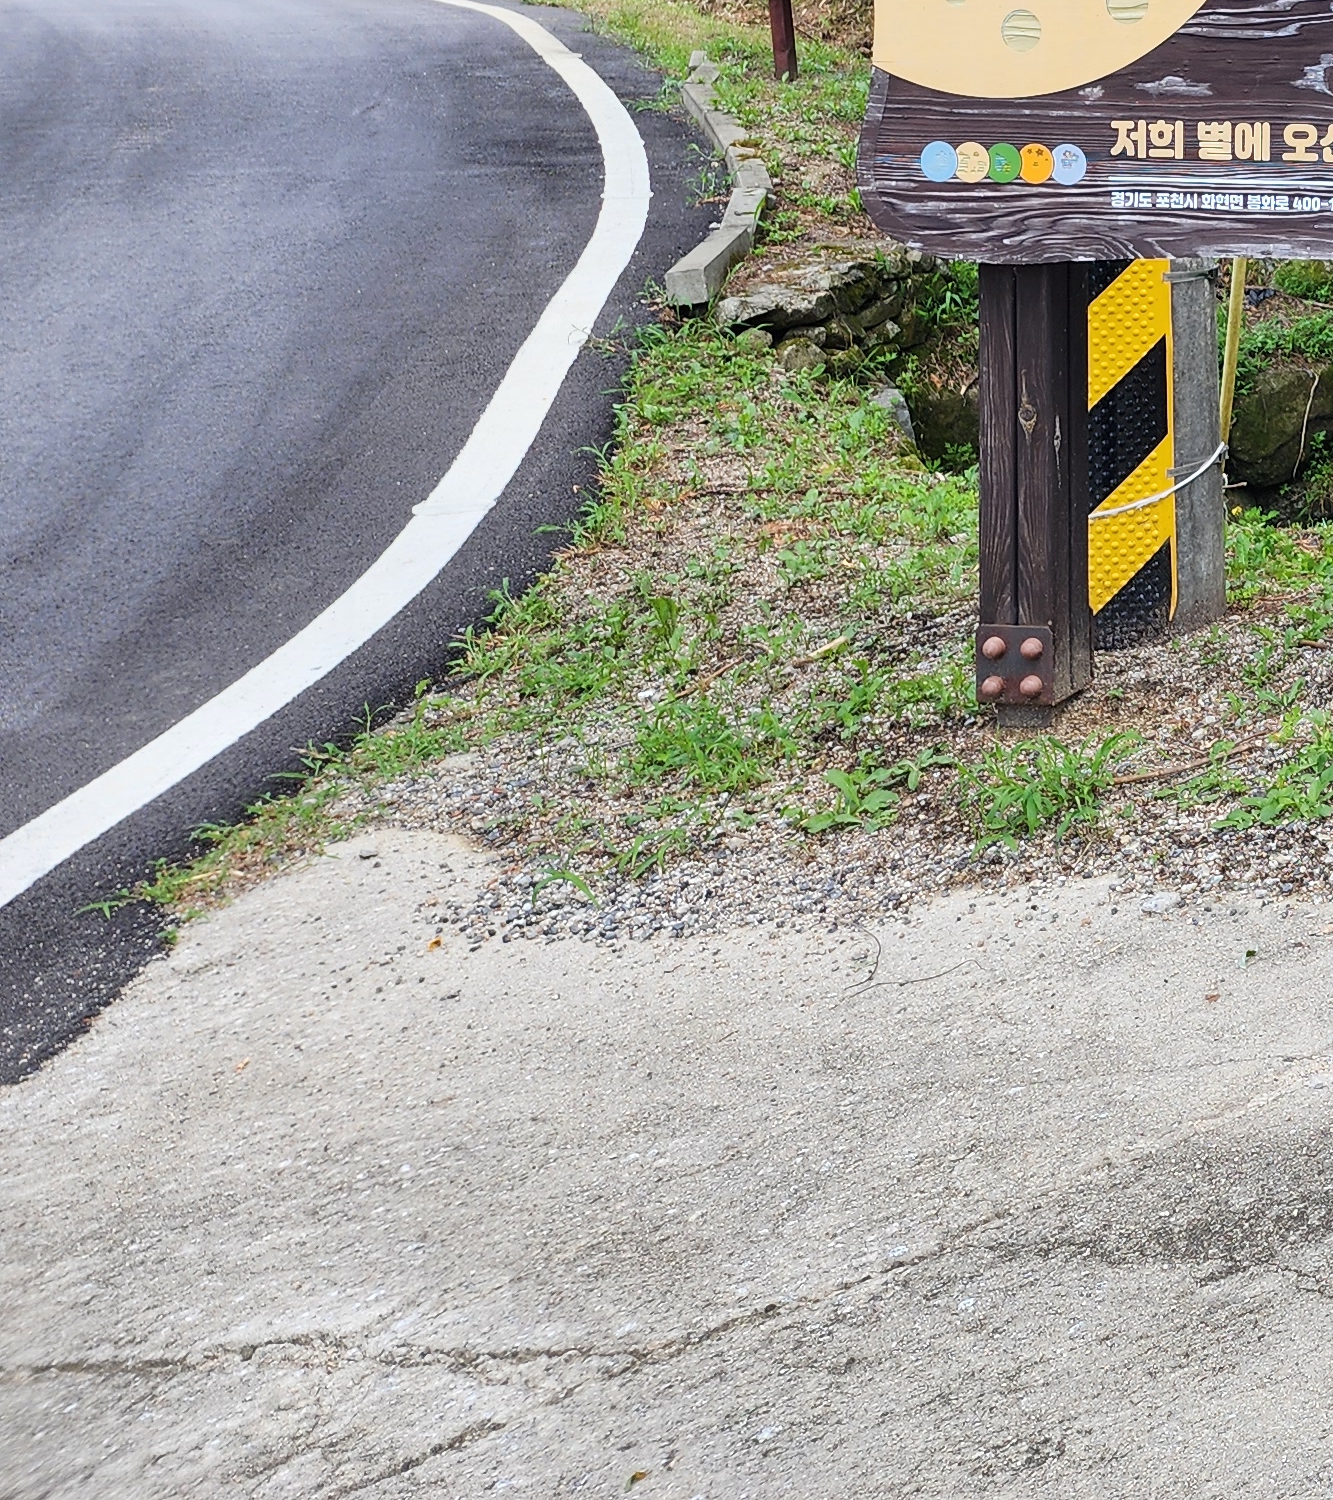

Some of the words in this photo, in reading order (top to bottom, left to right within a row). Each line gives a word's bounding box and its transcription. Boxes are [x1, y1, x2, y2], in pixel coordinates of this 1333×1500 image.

[1110, 119, 1184, 160] 저희
[1197, 120, 1271, 161] 별에
[1110, 191, 1153, 208] 경기도
[1156, 193, 1198, 209] 포천시
[1201, 193, 1244, 210] 화현면
